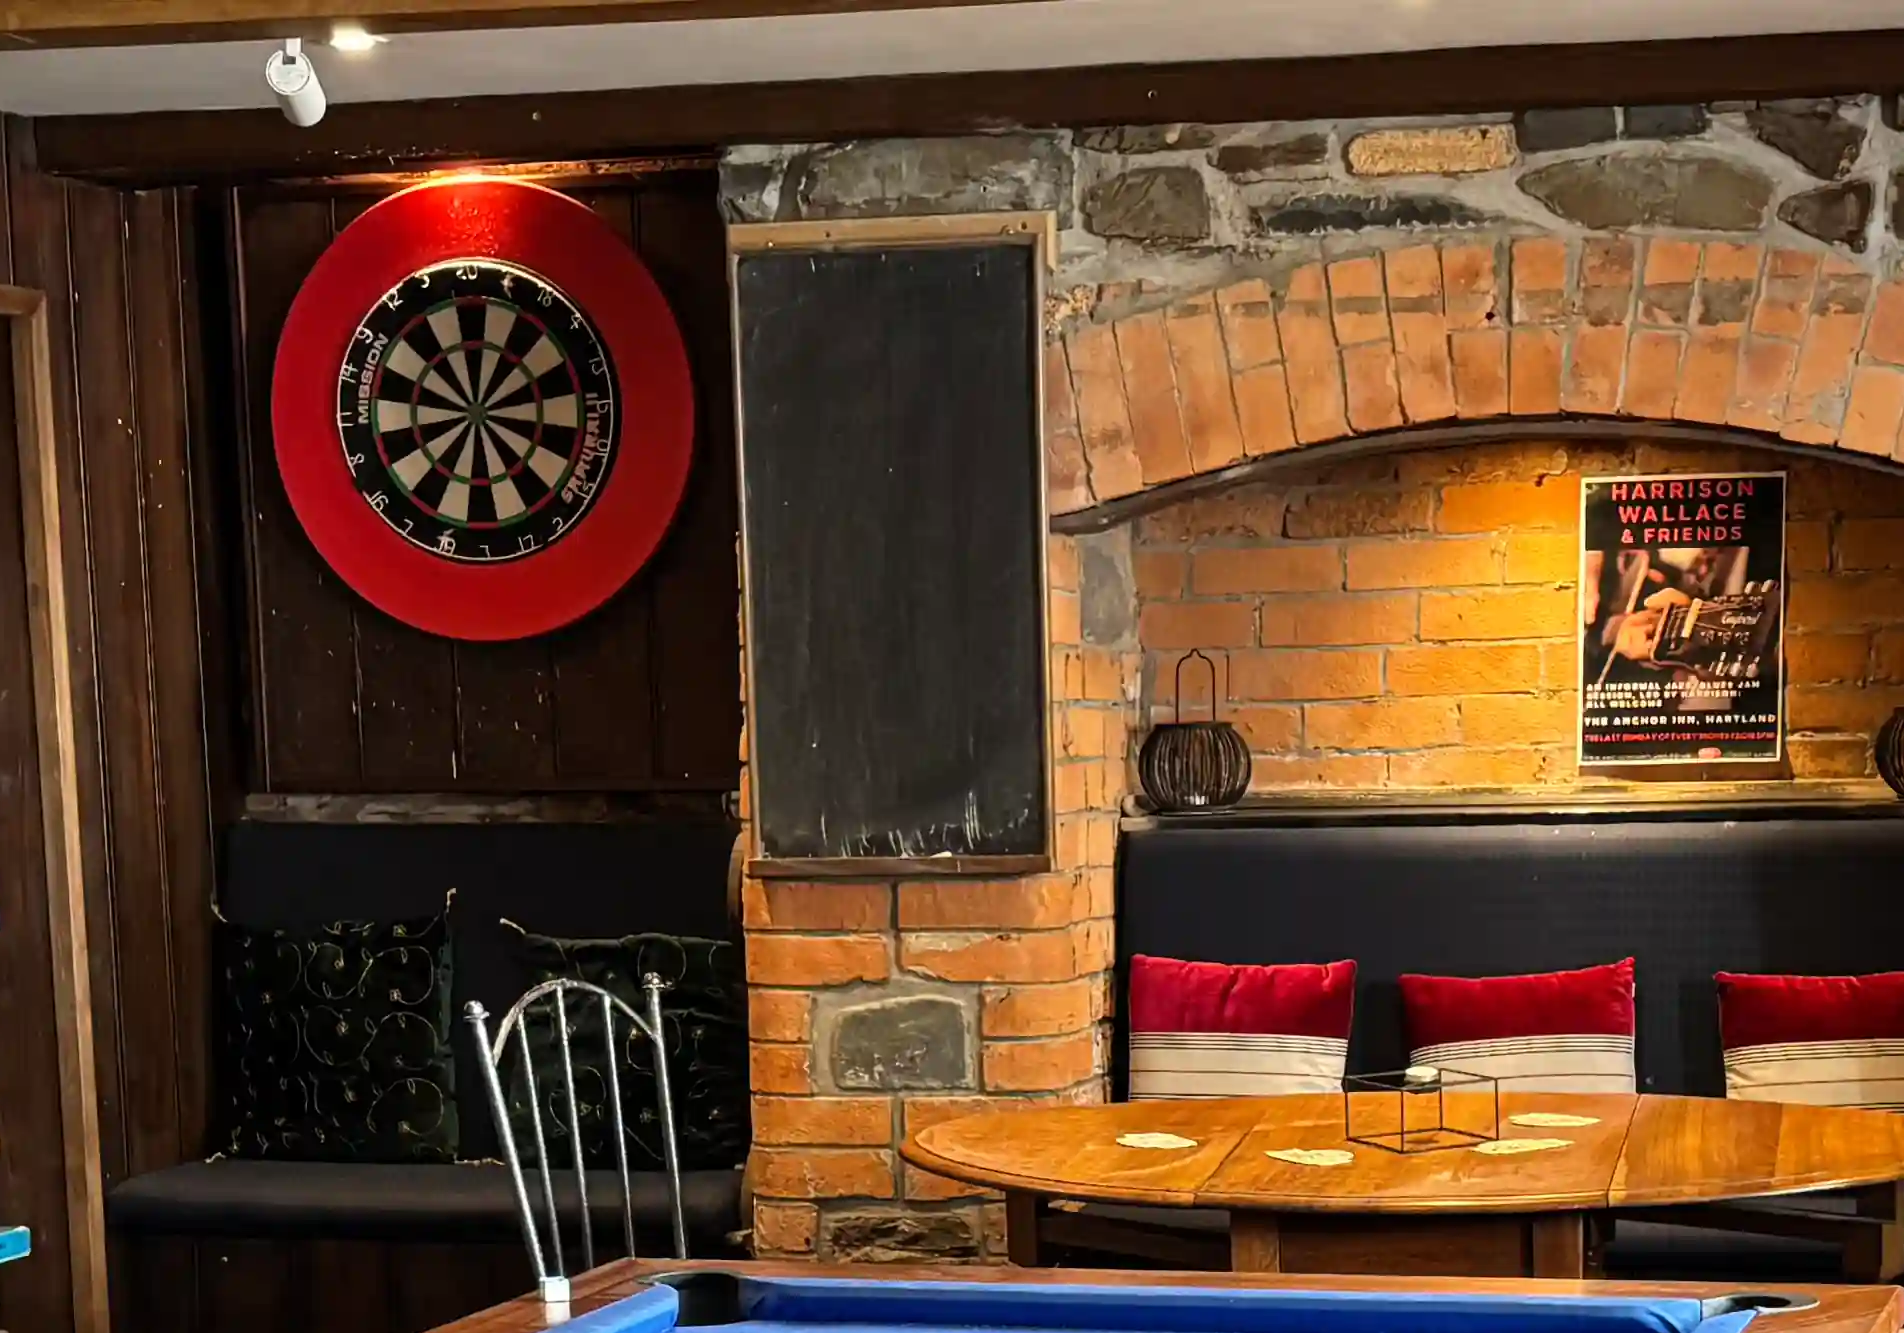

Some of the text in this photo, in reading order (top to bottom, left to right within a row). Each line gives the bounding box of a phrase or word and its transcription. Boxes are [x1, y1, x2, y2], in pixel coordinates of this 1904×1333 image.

[537, 289, 553, 307] 18
[570, 314, 582, 331] 4
[356, 326, 373, 344] 9
[341, 364, 359, 383] 14
[358, 333, 389, 424] MISSION
[341, 412, 355, 427] 11
[349, 452, 365, 467] 8
[1611, 480, 1754, 502] HARRISON
[1618, 503, 1746, 524] WALLACE
[552, 516, 564, 534] 2
[518, 534, 536, 553] 17
[1621, 526, 1743, 544] & FRIENDS
[1738, 680, 1761, 689] JAM
[1609, 699, 1663, 709] WELCOME
[1584, 714, 1777, 727] THE ANCHOR INN, HARTLAND
